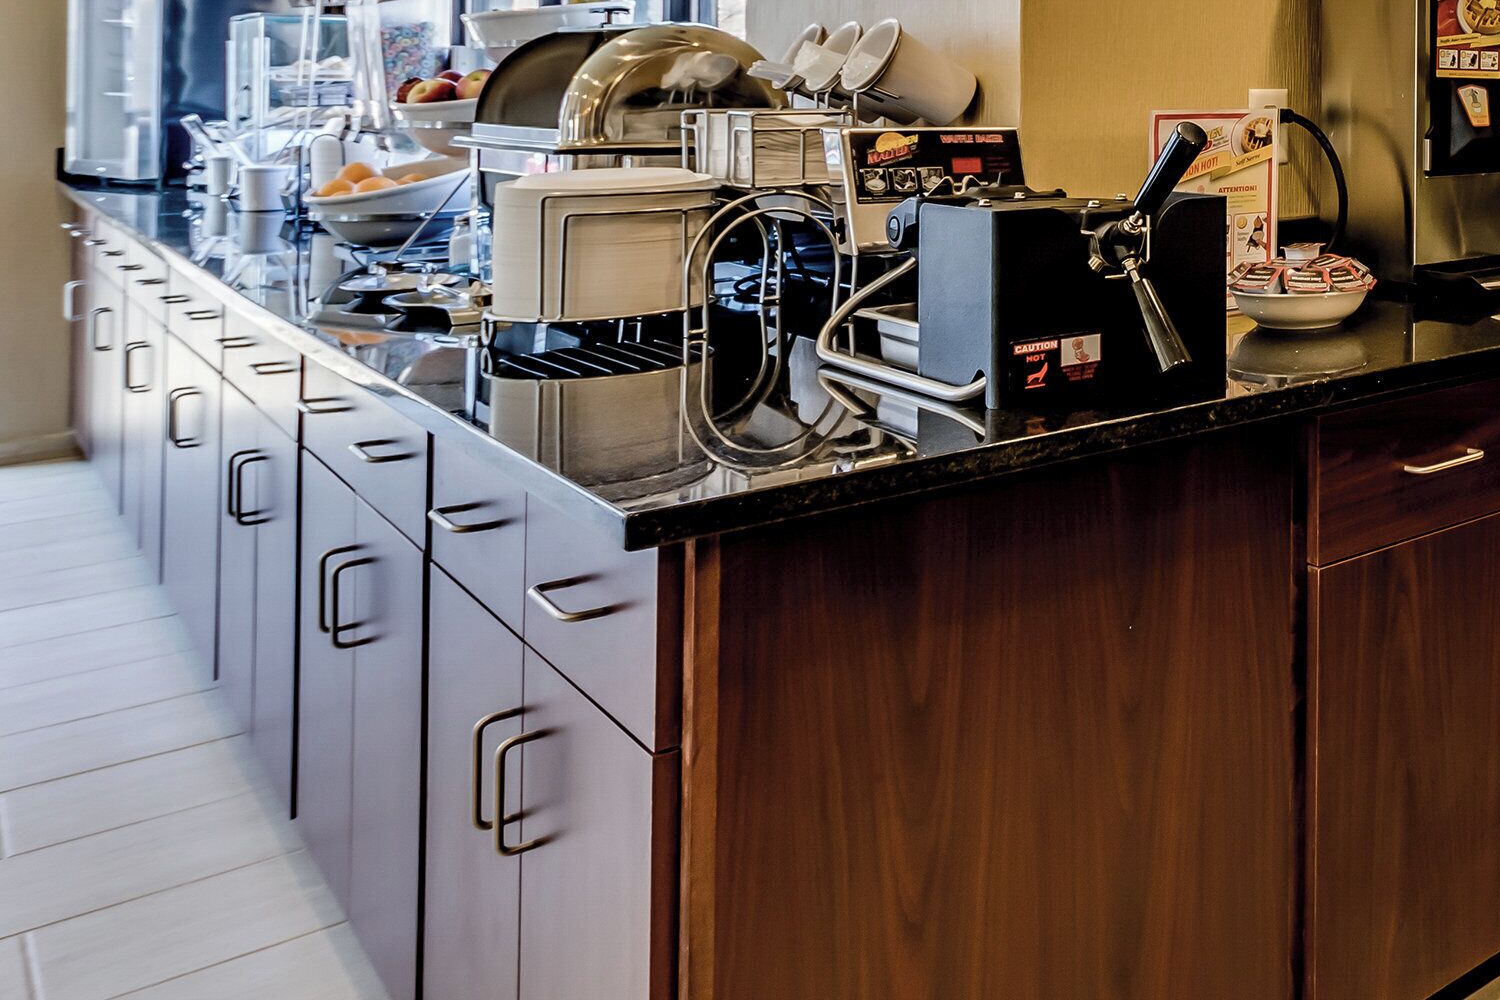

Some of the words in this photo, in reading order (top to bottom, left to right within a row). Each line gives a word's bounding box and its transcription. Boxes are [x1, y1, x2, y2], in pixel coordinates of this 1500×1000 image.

[939, 134, 974, 144] WAFFLE
[866, 145, 911, 166] MALTED
[1201, 155, 1219, 172] HOT!
[1217, 185, 1258, 194] ATTENTION!
[1014, 340, 1058, 355] CAUTION
[1026, 353, 1046, 363] HOT
